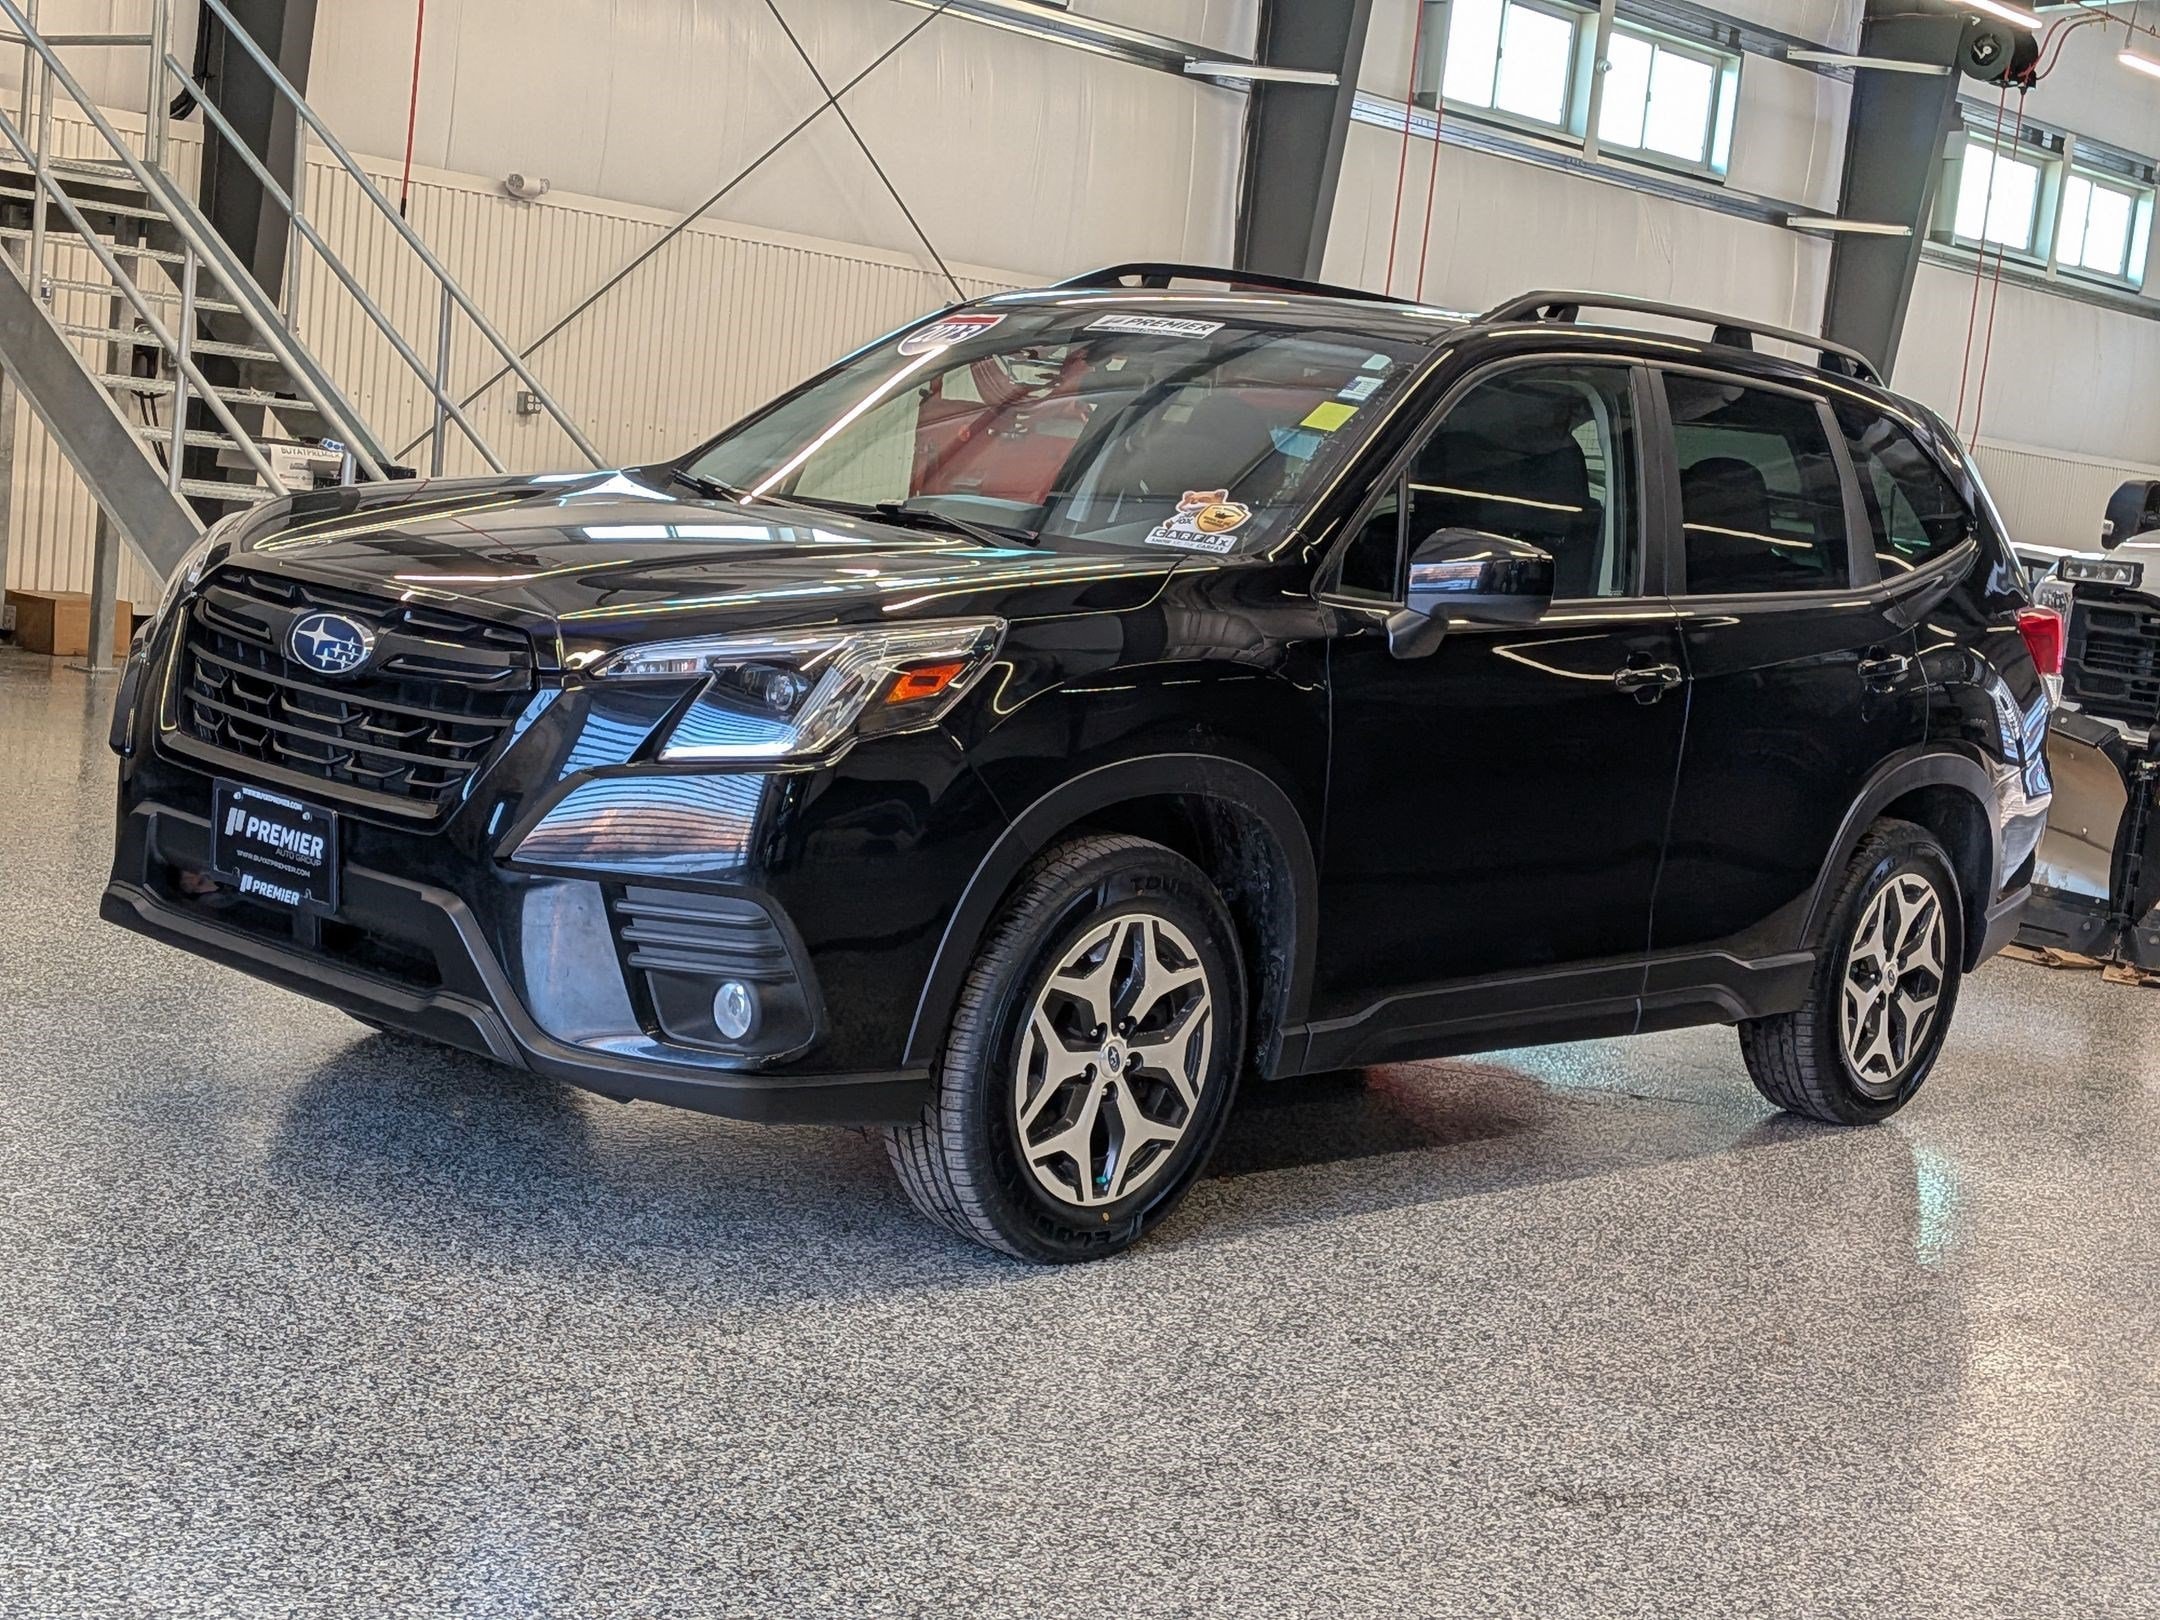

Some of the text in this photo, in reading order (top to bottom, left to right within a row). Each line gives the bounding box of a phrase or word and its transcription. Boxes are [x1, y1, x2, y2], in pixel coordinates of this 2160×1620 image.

[907, 324, 982, 343] 2023
[1124, 318, 1216, 331] PREMIER
[1154, 529, 1230, 547] CARFAX
[246, 816, 324, 859] PREMIER
[275, 848, 322, 867] AUTO GROUP
[252, 880, 300, 906] PREMIER
